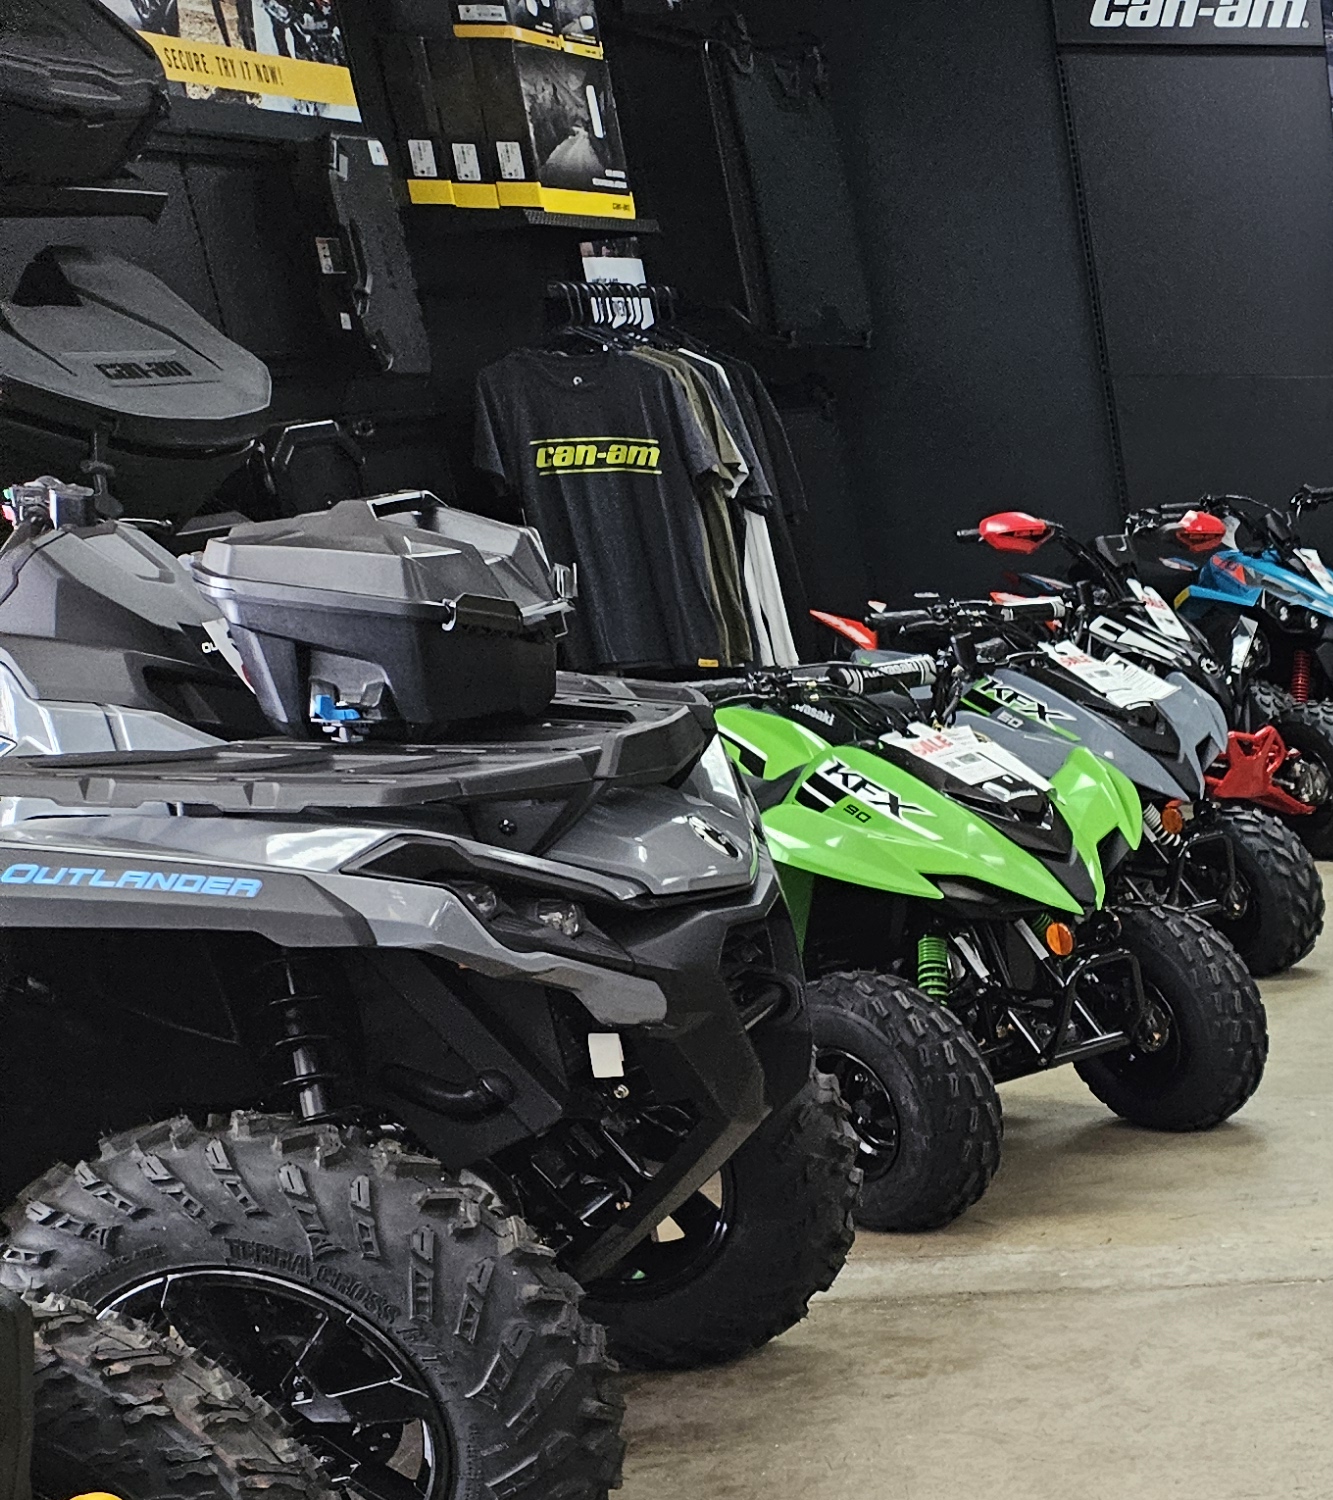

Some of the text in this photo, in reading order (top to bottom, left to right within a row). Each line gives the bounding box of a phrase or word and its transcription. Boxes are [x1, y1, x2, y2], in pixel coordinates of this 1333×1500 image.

[1090, 0, 1301, 28] can-am
[163, 47, 285, 86] SECURE. TRY IT NOW!
[536, 444, 661, 468] can-am
[979, 676, 1074, 725] KFX
[911, 734, 954, 756] SALE
[823, 760, 931, 819] KFX
[843, 804, 872, 823] 90
[1, 863, 263, 898] OUTLANDER
